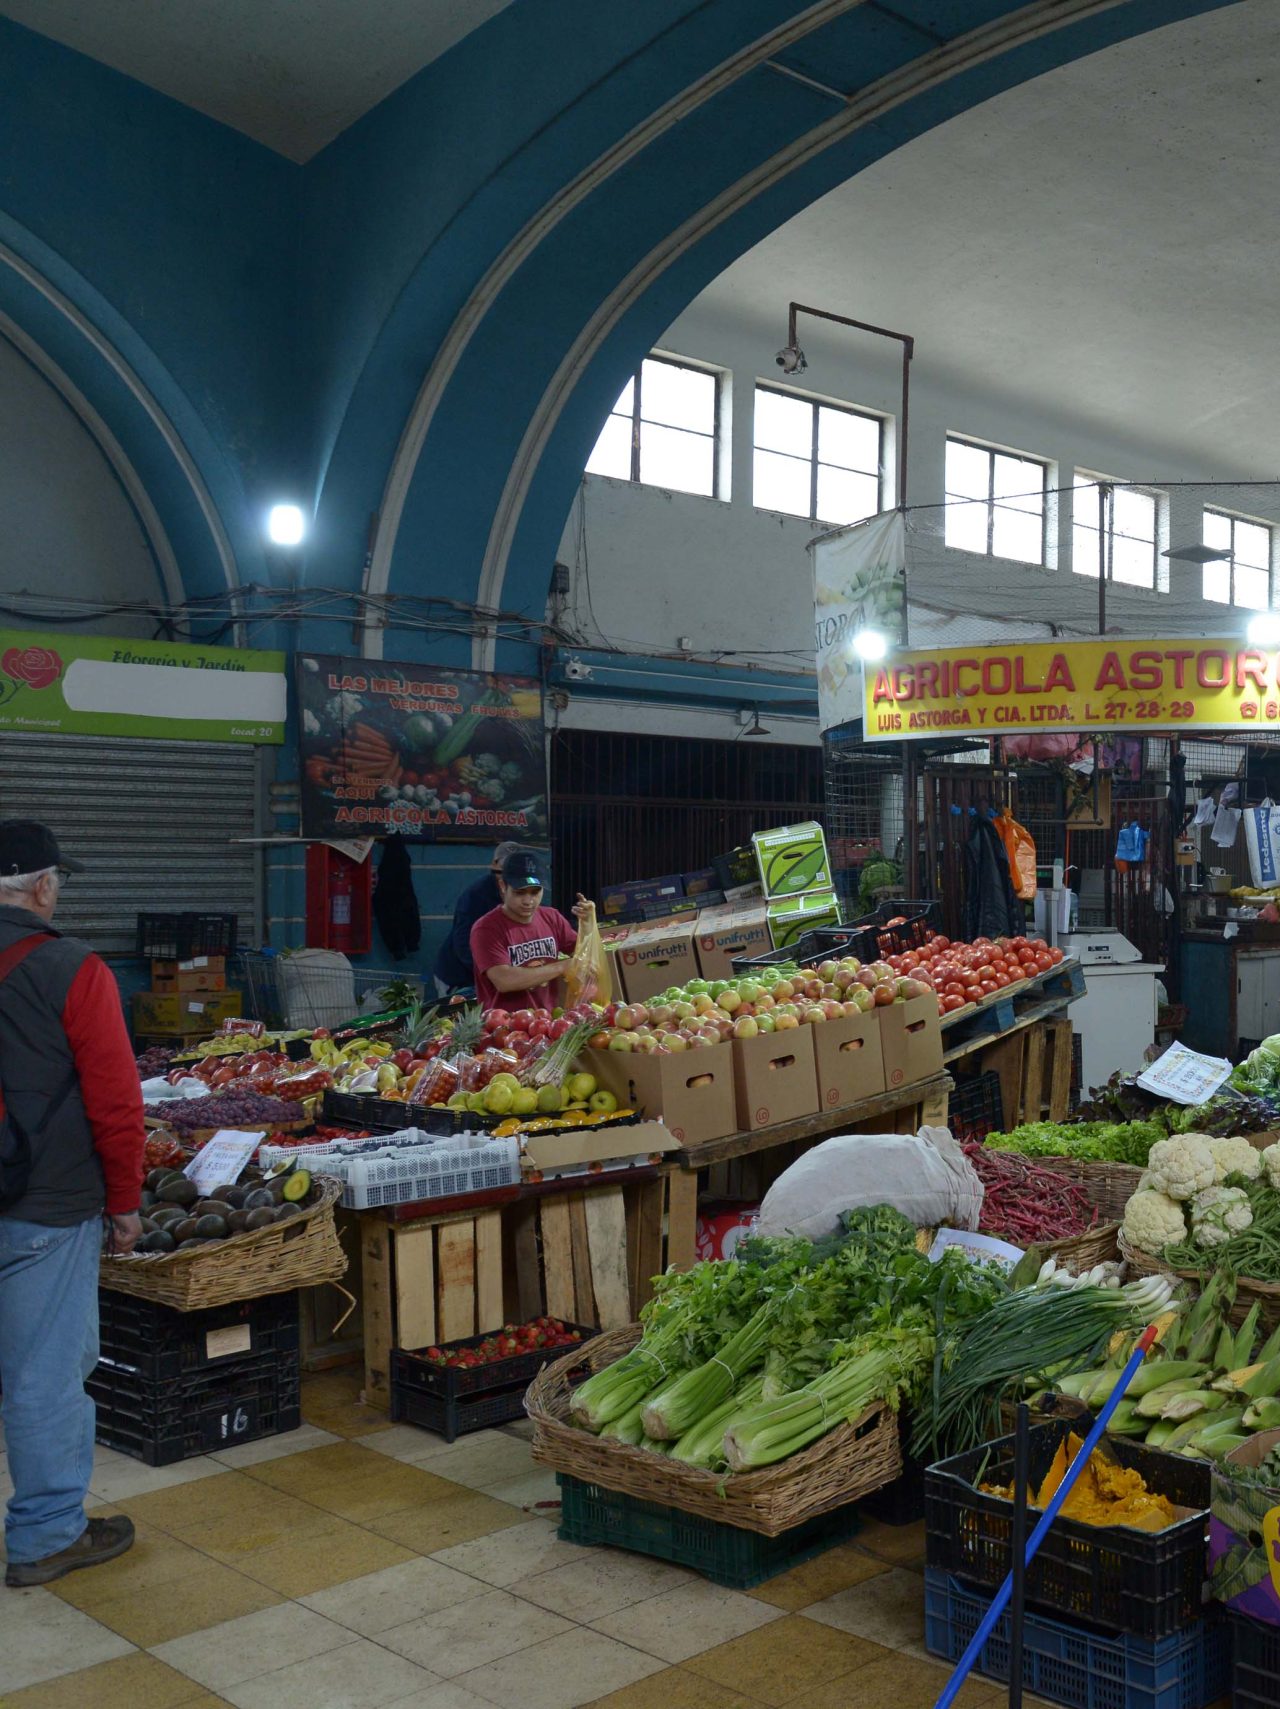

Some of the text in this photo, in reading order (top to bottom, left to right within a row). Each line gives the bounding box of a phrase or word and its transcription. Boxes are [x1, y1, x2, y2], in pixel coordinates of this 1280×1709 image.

[328, 674, 459, 699] LAS MEJORES
[873, 653, 1076, 704] AGRICOLA
[389, 698, 521, 718] VERDURAS FRUTAS
[878, 713, 902, 732] LUIS
[909, 708, 971, 729] ASTORGA
[977, 707, 988, 724] Y
[994, 706, 1027, 722] CIA.
[1030, 704, 1074, 722] LTDA.
[259, 727, 273, 737] 20
[335, 806, 528, 828] AGRICOLA ASTORGA
[1259, 808, 1271, 874] Ledesma
[717, 928, 765, 946] unifrutti
[638, 942, 687, 960] unifrutti
[220, 1407, 249, 1439] 16
